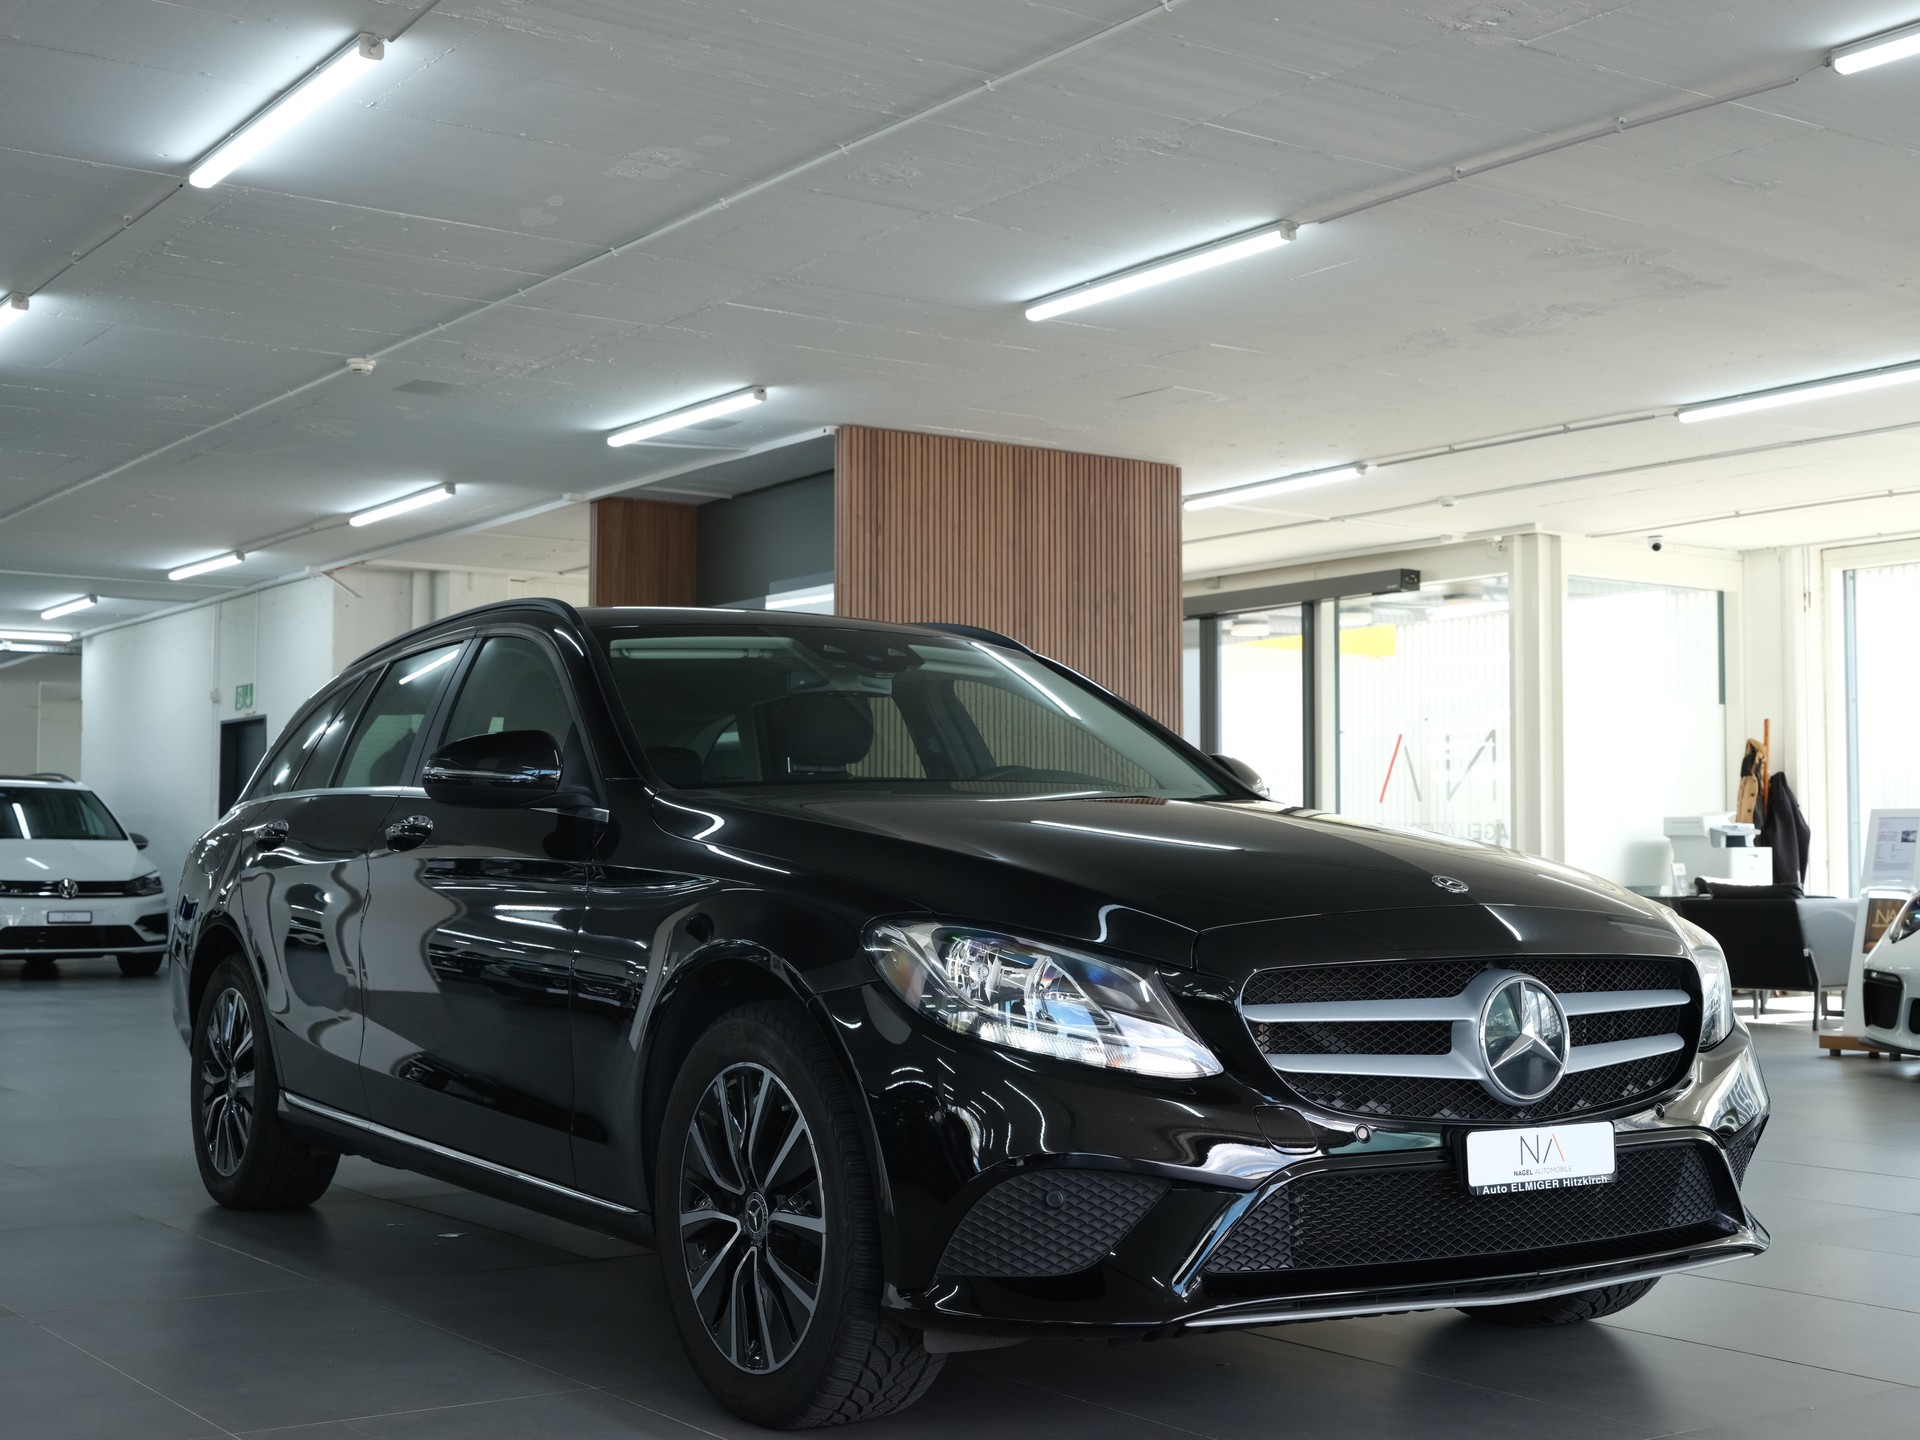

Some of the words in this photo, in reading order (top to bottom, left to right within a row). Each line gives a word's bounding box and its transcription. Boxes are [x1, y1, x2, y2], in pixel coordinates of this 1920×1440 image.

[1519, 1133, 1565, 1166] NA
[1513, 1169, 1534, 1177] NAGEL
[1535, 1165, 1573, 1176] AUTOMOBILE
[1482, 1185, 1508, 1195] Auto
[1511, 1179, 1560, 1193] ELMIGER
[1563, 1175, 1608, 1188] Hitzkirch
